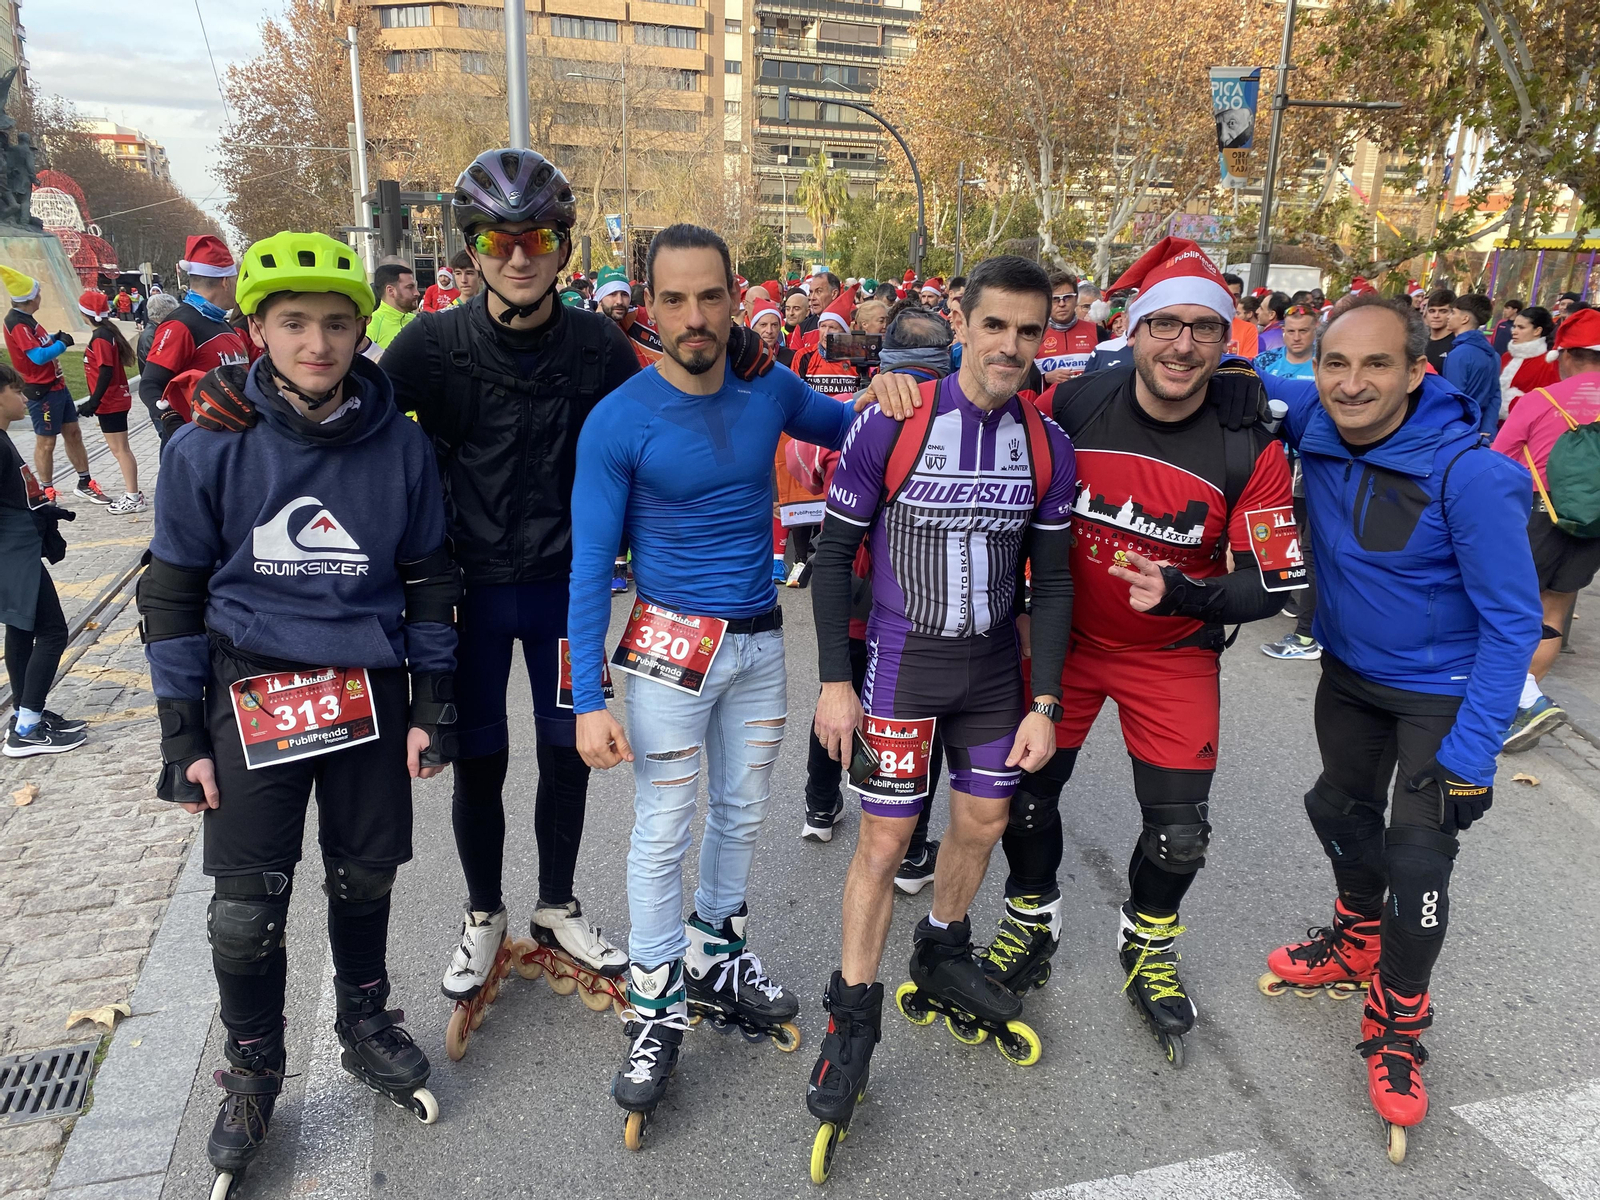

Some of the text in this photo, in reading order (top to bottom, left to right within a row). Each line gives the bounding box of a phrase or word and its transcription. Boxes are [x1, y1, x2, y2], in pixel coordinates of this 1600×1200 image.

[1211, 81, 1243, 97] PICA
[1174, 250, 1217, 274] PubliPrenda
[1007, 464, 1029, 472] HUNTER
[1078, 528, 1119, 547] Santa
[958, 536, 968, 573] SKATE
[253, 561, 369, 576] QUIKSILVER
[961, 576, 968, 590] TO
[959, 593, 968, 620] LOVE
[635, 625, 691, 661] 320
[636, 656, 682, 678] PubliPrenda
[273, 695, 341, 731] 313
[288, 727, 348, 748] PubliPrenda
[868, 777, 915, 789] PubliPrenda
